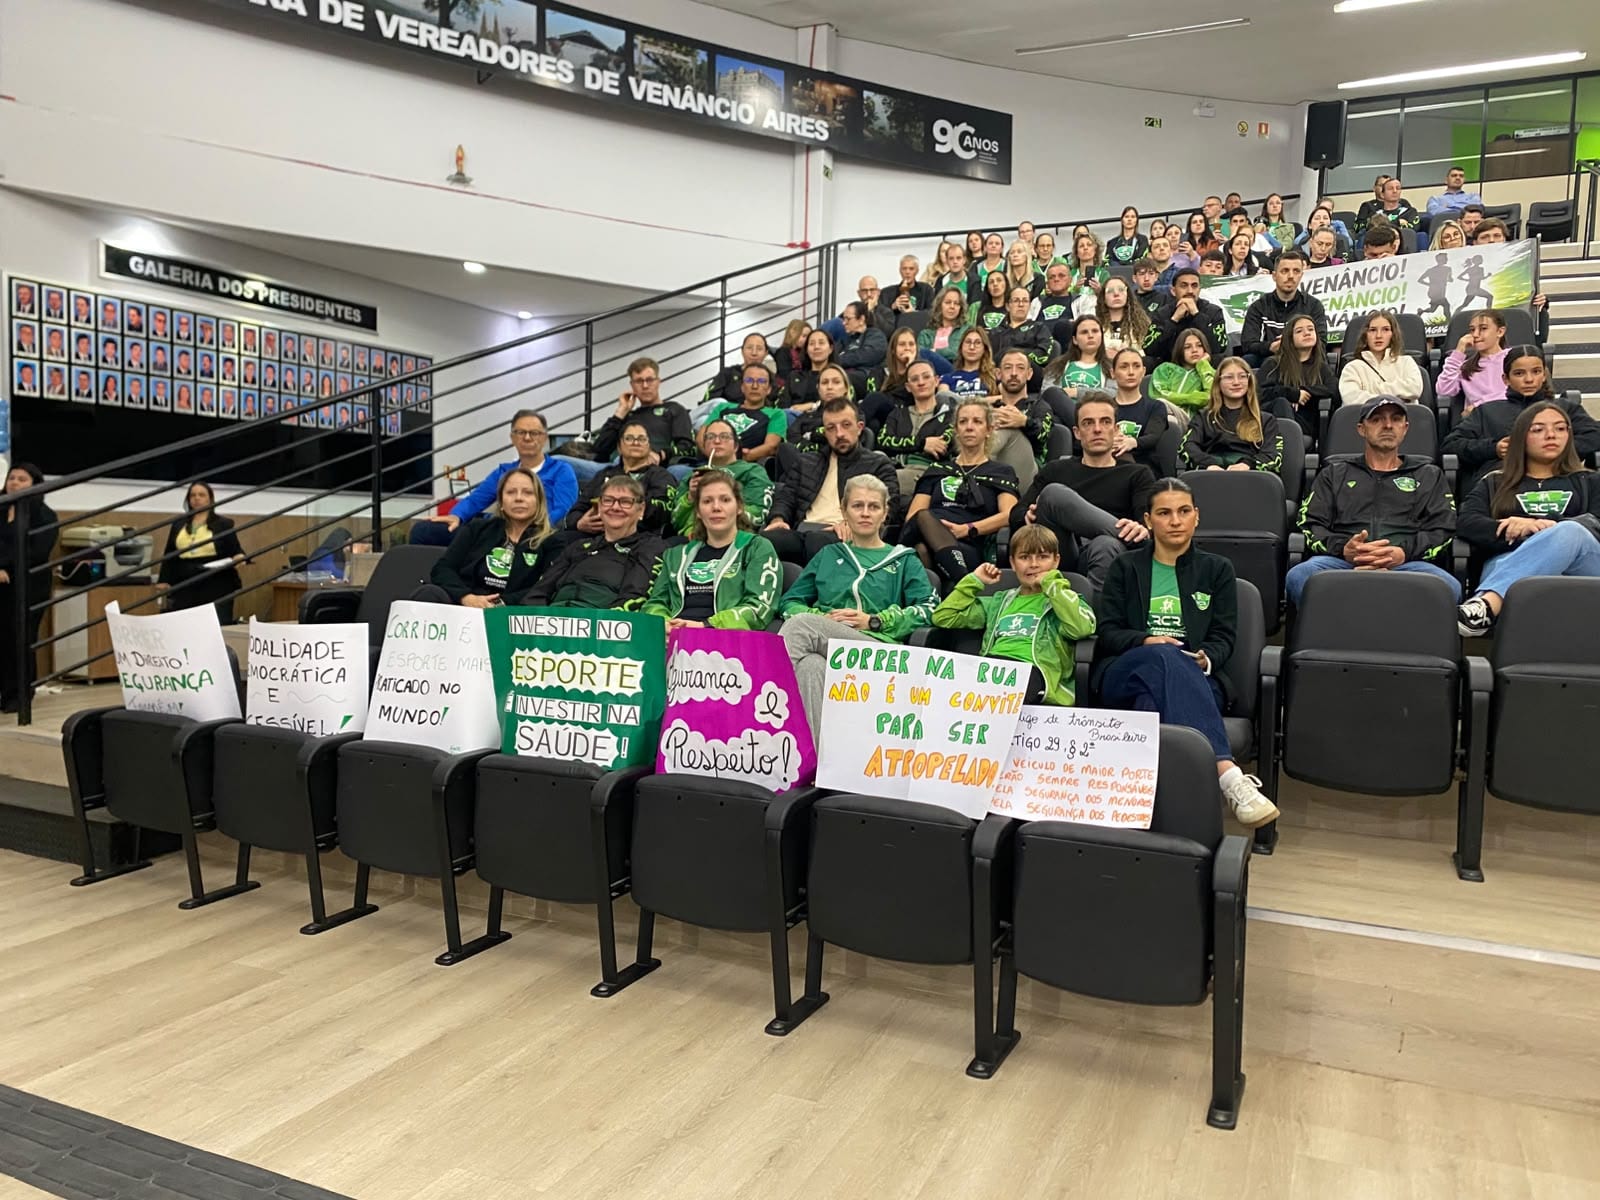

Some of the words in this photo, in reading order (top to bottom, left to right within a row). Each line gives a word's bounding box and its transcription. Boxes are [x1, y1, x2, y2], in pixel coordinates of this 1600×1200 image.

[375, 10, 574, 83] VEREADORES
[584, 65, 620, 96] DE
[628, 77, 754, 126] VENÂNCIO
[762, 107, 829, 141] AIRES
[963, 135, 999, 153] ANOS
[1300, 258, 1408, 295] VENÂNCIO!
[128, 256, 213, 290] GALERIA
[218, 277, 256, 299] DOS
[258, 284, 362, 323] PRESIDENTES
[1319, 281, 1408, 311] ENÂNCIO!
[1529, 503, 1560, 511] RCR
[387, 614, 448, 641] CORRIDA
[509, 616, 590, 638] INVESTIR
[599, 620, 632, 641] NO
[1151, 615, 1181, 626] RCR
[515, 656, 638, 689] ESPORTE
[829, 646, 911, 675] CORRER
[925, 655, 955, 681] NA
[977, 662, 1018, 687] RUA
[121, 668, 214, 693] EGURANÇA
[440, 683, 461, 695] NO
[828, 673, 870, 704] NÃO
[887, 675, 896, 704] É
[909, 686, 931, 706] UM
[267, 687, 280, 703] E
[378, 705, 450, 726] MUNDO!
[515, 696, 599, 721] INVESTIR
[608, 706, 639, 724] NA
[876, 712, 924, 740] PARA
[947, 721, 990, 745] SER
[517, 726, 611, 763] SAÚDE
[1010, 733, 1041, 752] TIGO
[1037, 774, 1080, 788] SEMPRE
[1063, 764, 1075, 775] DE
[1121, 767, 1155, 780] PORTE
[992, 784, 1014, 795] ELA
[1024, 786, 1080, 805] SEGURANÇA
[1086, 794, 1102, 805] DOS
[991, 797, 1012, 811] ELA
[1026, 803, 1085, 821] SEGURANÇA
[1089, 809, 1105, 821] DOS
